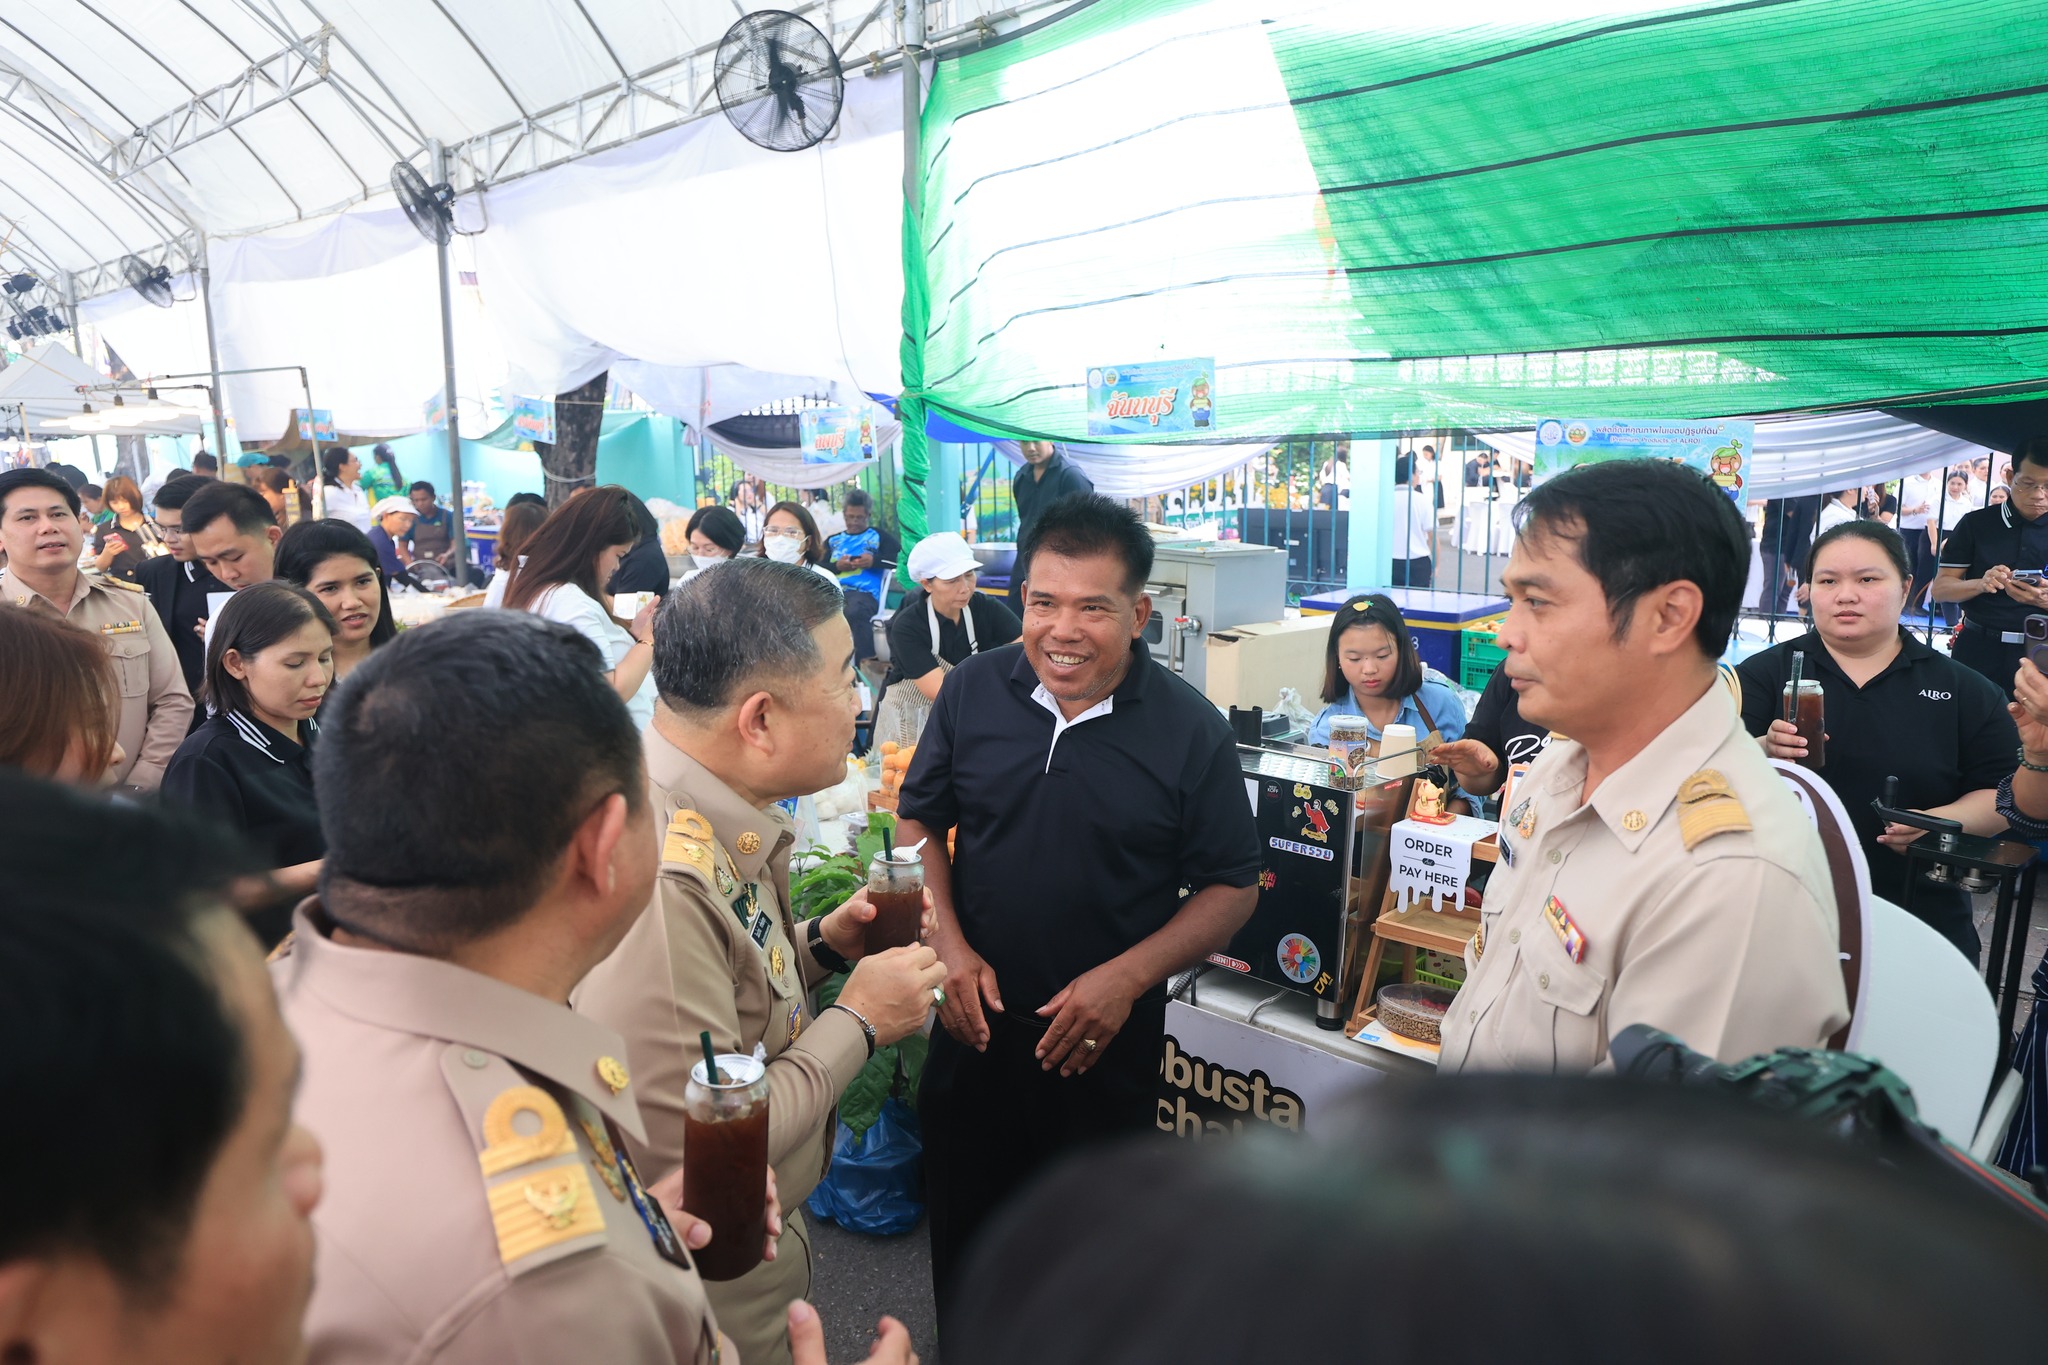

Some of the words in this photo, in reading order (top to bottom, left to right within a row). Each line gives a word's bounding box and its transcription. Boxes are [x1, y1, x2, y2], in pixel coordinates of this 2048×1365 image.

[1107, 389, 1177, 425] จันทบุรี
[1404, 837, 1453, 858] ORDER
[1399, 864, 1422, 878] PAY
[1424, 870, 1459, 888] HERE
[1159, 1040, 1300, 1134] busta
